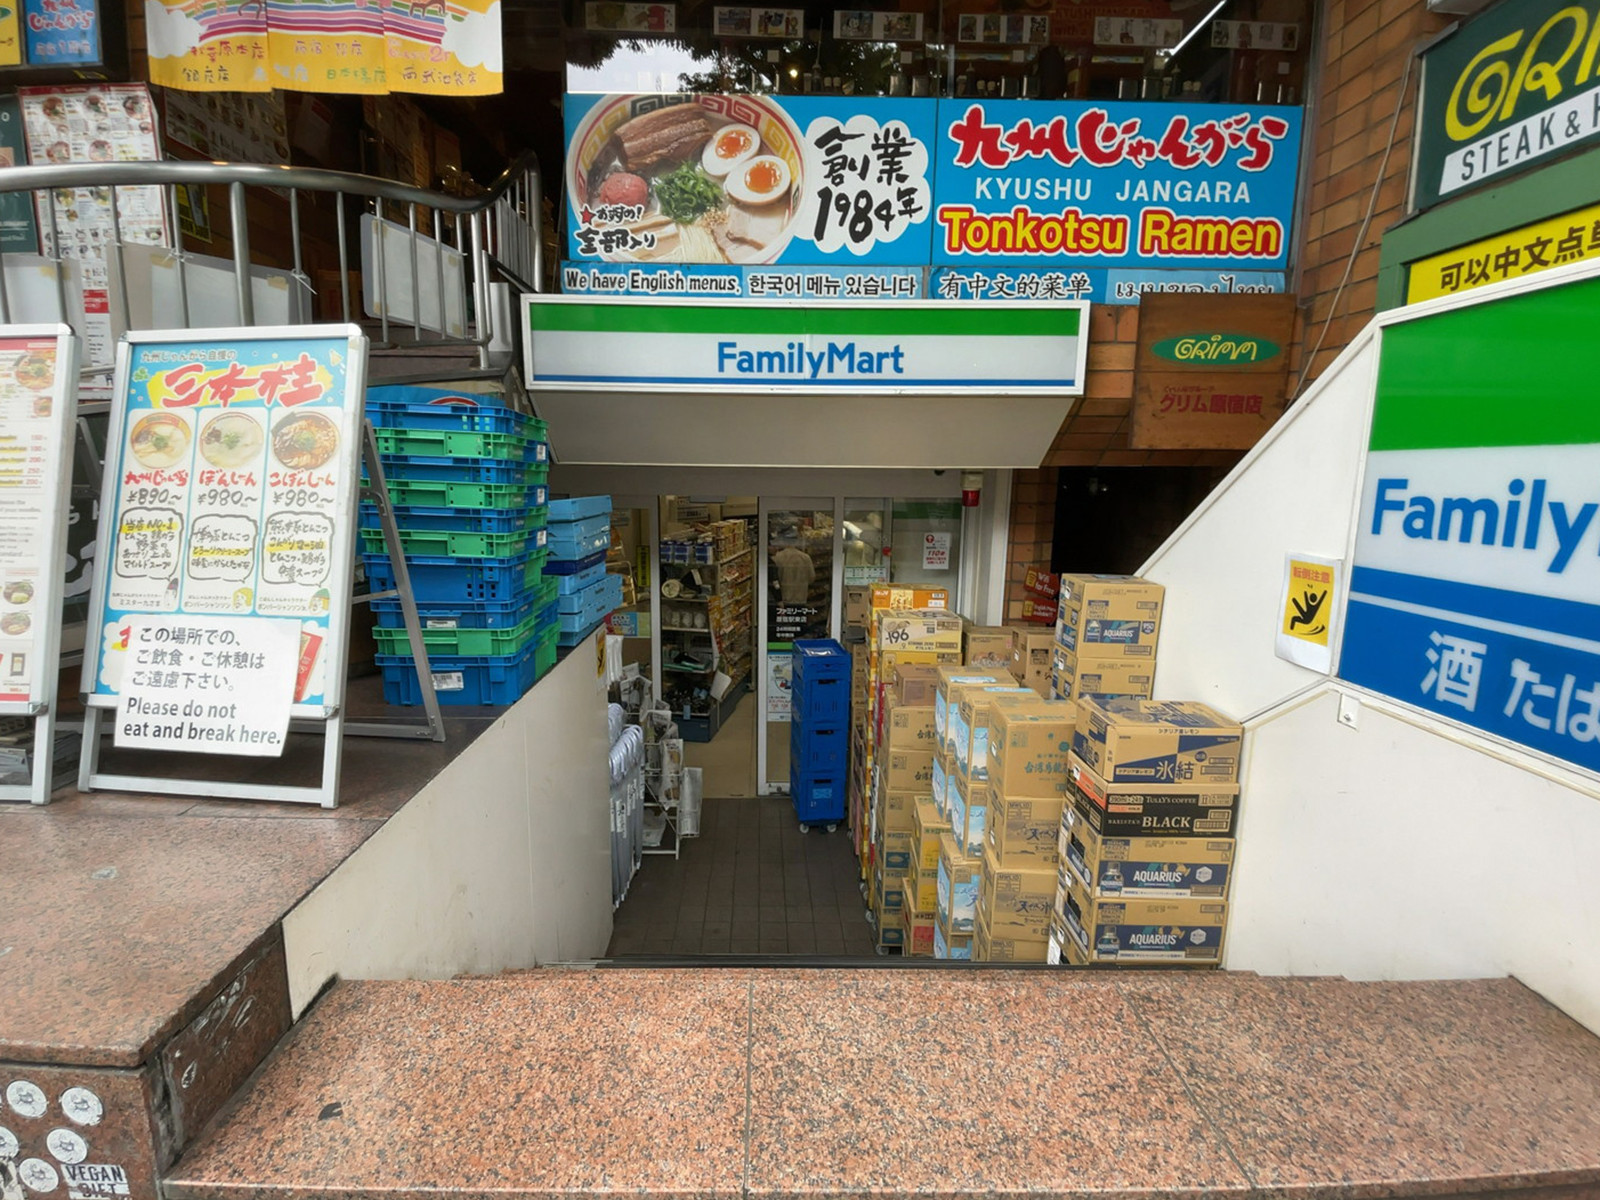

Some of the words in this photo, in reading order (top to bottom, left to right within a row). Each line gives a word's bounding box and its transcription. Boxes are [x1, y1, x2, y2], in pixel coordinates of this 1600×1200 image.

[951, 105, 1288, 169] 九州じゃんがら
[1461, 112, 1556, 182] STEAK
[1564, 110, 1581, 138] &
[814, 126, 916, 187] 創業
[975, 178, 1092, 200] KYUSHU
[1116, 179, 1250, 203] JANGARA
[813, 187, 923, 244] 1984年
[576, 227, 655, 254] 全部入り
[942, 210, 1123, 252] Tonkotsu
[1142, 212, 1280, 253] Ramen
[566, 270, 587, 289] We
[592, 271, 626, 289] have
[630, 272, 684, 292] English
[749, 275, 800, 296] 한국어
[807, 275, 841, 296] 메뉴
[845, 275, 916, 297] 있습니다
[939, 274, 1091, 299] 有中文的菜单
[717, 341, 905, 379] FamilyMart
[162, 353, 324, 408] 三本柱
[1103, 628, 1134, 637] AQUARIUS
[136, 648, 266, 669] ご飲食・ご休憩は
[132, 671, 234, 691] ご遠慮下さい。
[1420, 630, 1487, 713] 酒
[126, 697, 178, 717] Please
[183, 699, 203, 718] do
[207, 702, 237, 720] not
[123, 722, 149, 737] eat
[153, 722, 184, 740] and
[188, 722, 236, 743] break
[239, 725, 281, 745] here.
[1156, 760, 1194, 780] 氷結
[1142, 816, 1191, 828] BLACK
[1133, 870, 1182, 882] AQUARIUS
[1129, 934, 1177, 945] AQUARIUS
[65, 1165, 124, 1182] VEGAN
